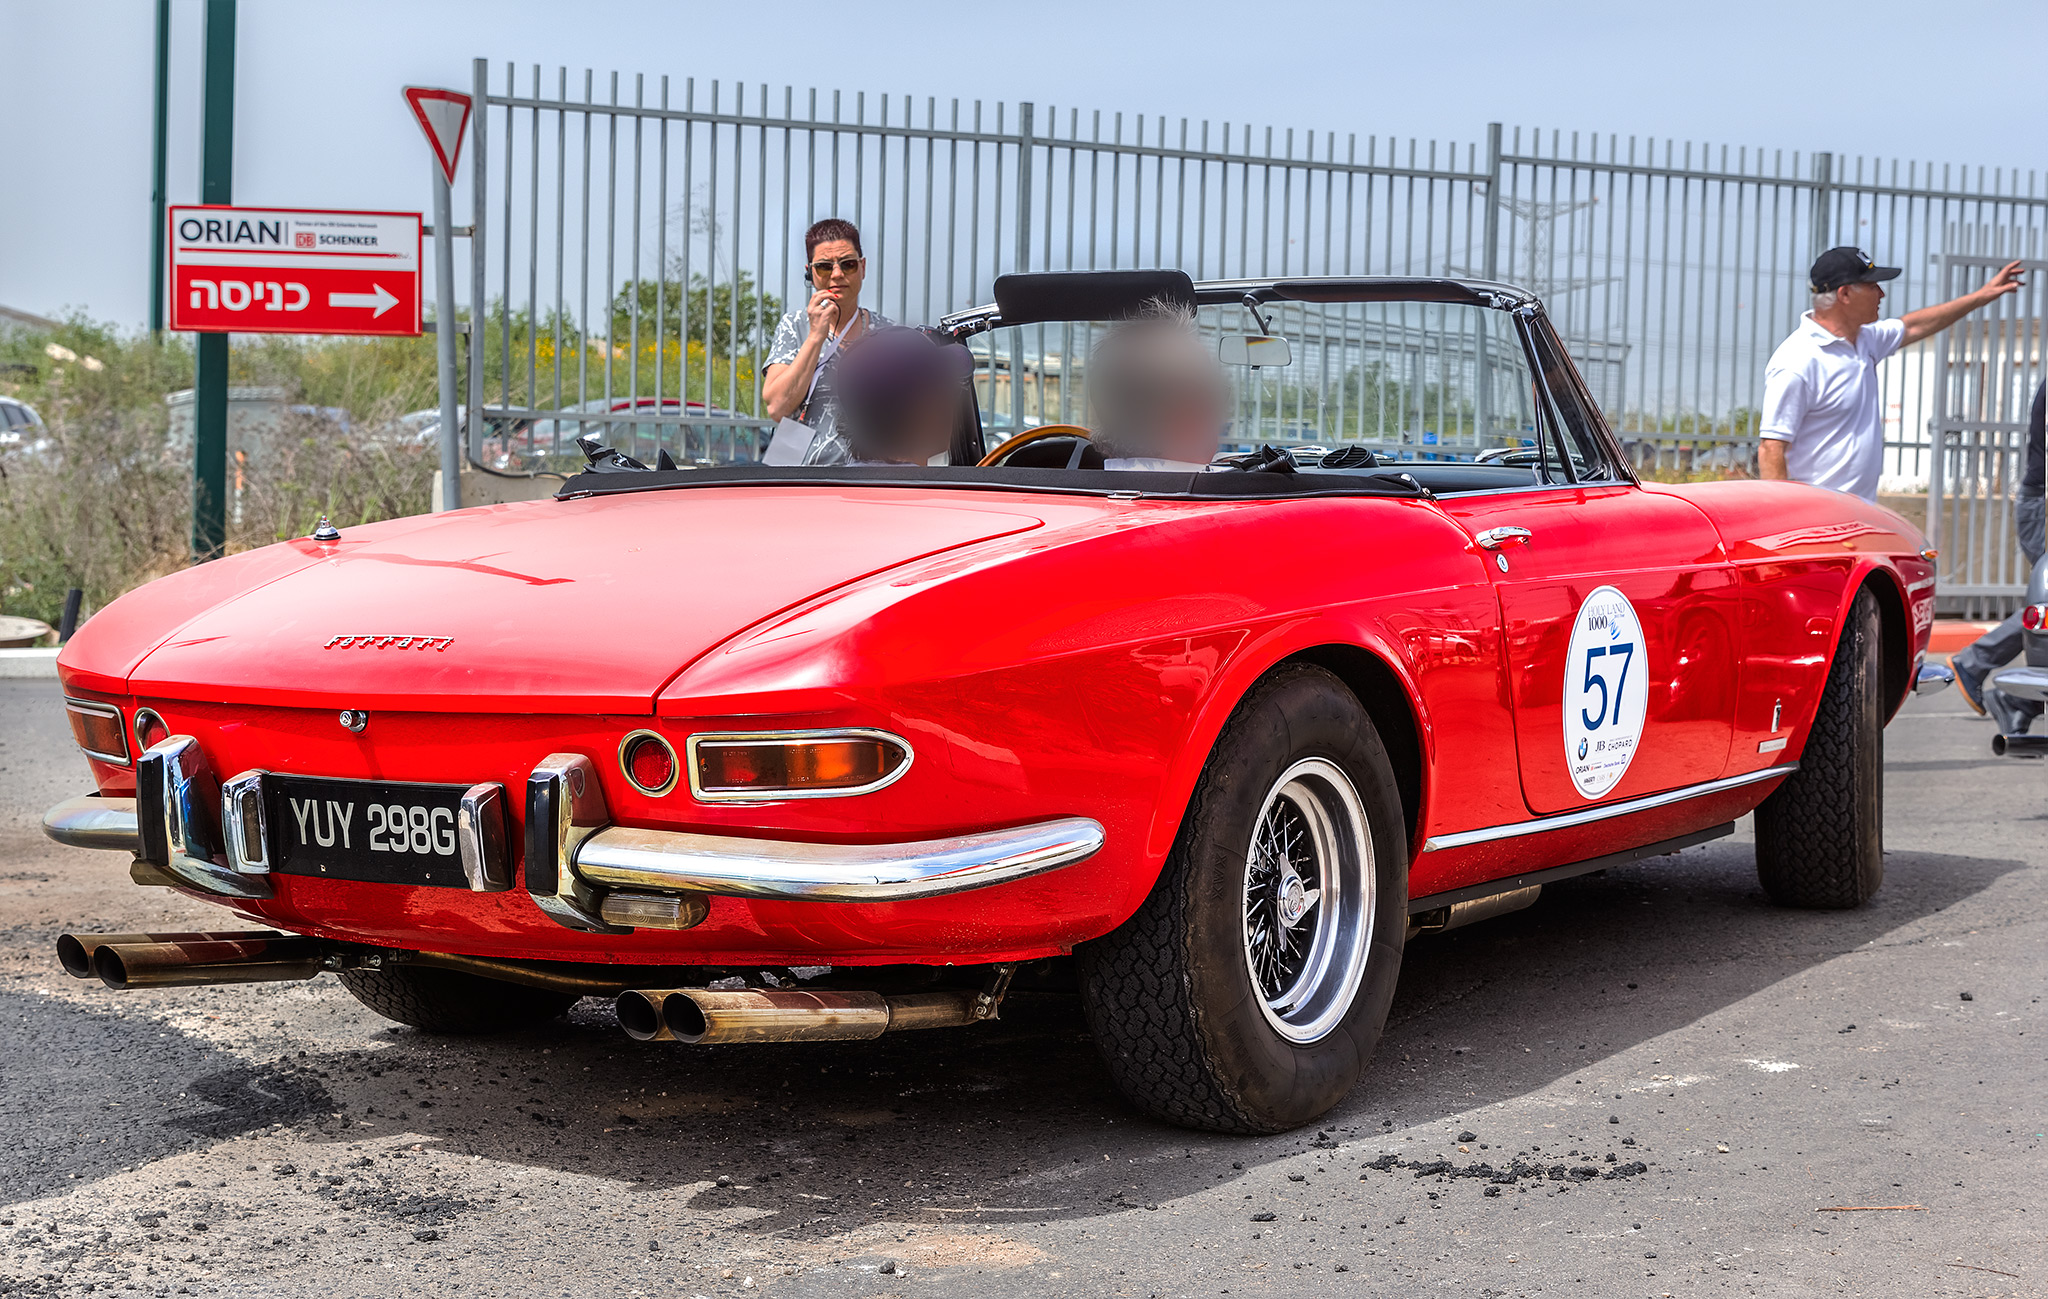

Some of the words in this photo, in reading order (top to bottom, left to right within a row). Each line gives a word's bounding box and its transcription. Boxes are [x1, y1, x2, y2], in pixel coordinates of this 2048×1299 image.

[180, 219, 280, 244] ORIAN
[296, 232, 316, 248] DB
[319, 233, 379, 246] SCHENKER
[190, 279, 311, 311] כניסה
[1588, 615, 1608, 630] 1000
[1582, 642, 1634, 731] 57
[289, 798, 354, 849] YUY
[367, 804, 456, 855] 298G
